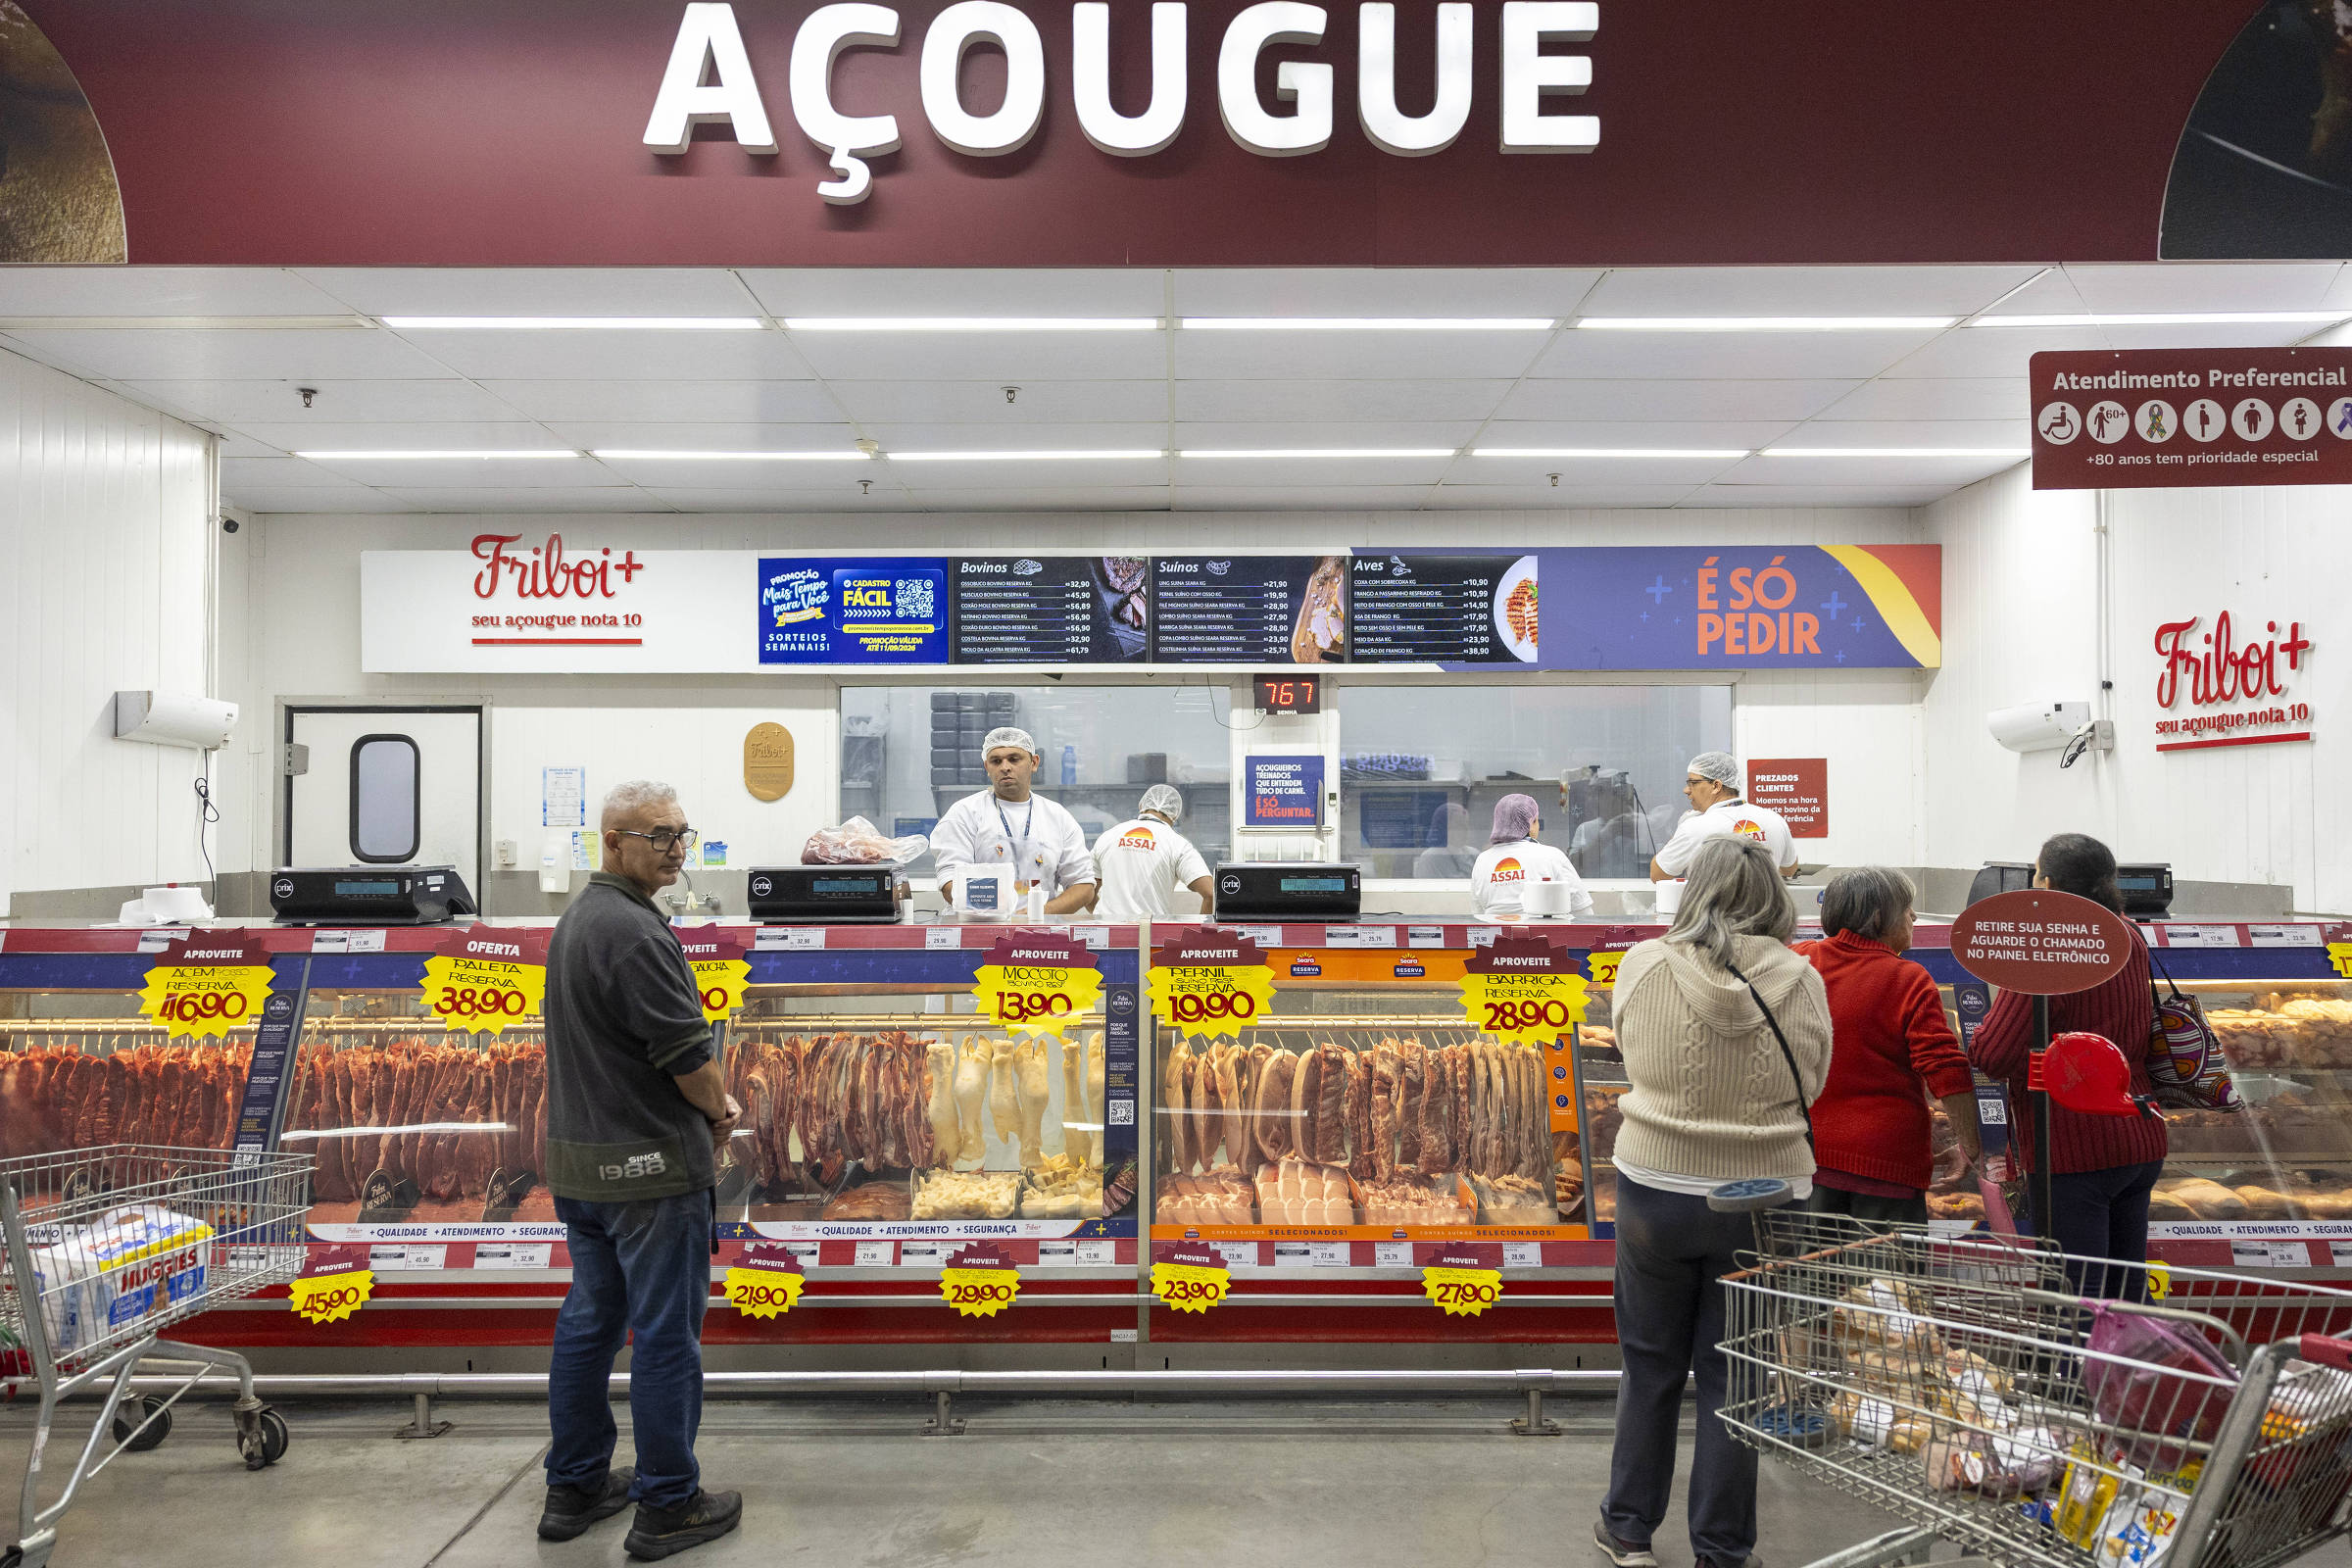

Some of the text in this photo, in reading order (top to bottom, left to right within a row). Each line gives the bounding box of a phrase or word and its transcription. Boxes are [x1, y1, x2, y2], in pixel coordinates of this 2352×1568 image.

[643, 0, 1601, 206] AÇOUGUE
[2053, 368, 2346, 390] Atendimento Preferencial
[2106, 410, 2126, 419] 60+
[2086, 450, 2318, 466] +80 anos tem prioridade especial
[961, 562, 1007, 572] Bovinos
[1159, 562, 1199, 572] Suínos
[1354, 560, 1384, 571] Aves
[770, 569, 819, 586] PROMOÇÃO
[1698, 556, 1796, 610] É SÓ
[762, 580, 828, 606] Mais Tempo
[844, 588, 892, 606] FÁCIL
[774, 602, 800, 617] para
[801, 593, 829, 609] Você
[472, 613, 642, 629] seu açougue nota 10
[859, 636, 899, 645] PROMOÇÃO
[1698, 612, 1822, 655] PEDIR
[2156, 703, 2308, 736] seu açougue nota 10
[1256, 796, 1278, 808] É SÓ
[1256, 808, 1314, 817] PERGUNTAR.
[1118, 838, 1156, 852] ASSAI
[1491, 870, 1525, 883] ASSAI
[276, 884, 292, 894] prix
[754, 882, 771, 891] prix
[1976, 921, 2099, 934] RETIRE SUA SENHA E
[467, 941, 519, 956] OFERTA
[1971, 936, 2105, 949] AGUARDE O CHAMADO
[184, 950, 243, 958] APROVEITE
[1011, 950, 1069, 958] APROVEITE
[1181, 950, 1238, 958] APROVEITE
[1967, 949, 2109, 964] NO PAINEL ELETRÔNICO
[453, 958, 522, 974] PALETA
[1493, 957, 1550, 966] APROVEITE
[172, 968, 216, 977] ACEM
[1167, 967, 1232, 977] PERNIL
[449, 972, 518, 989] RESERVA
[1484, 975, 1566, 985] BARRIGA
[1169, 984, 1237, 993] RESERVA
[1486, 989, 1551, 998] RESERVA
[159, 992, 247, 1025] 46,90
[434, 987, 525, 1020] 38,90
[997, 992, 1072, 1022] 13,90
[1485, 1001, 1569, 1033] 28,90
[628, 1152, 662, 1163] SINCE
[599, 1159, 666, 1181] 1988
[376, 1227, 566, 1237] QUALIDADE ATENDIMENTO SEGURANÇ
[886, 1225, 949, 1235] ATENDIMENTO
[964, 1225, 1016, 1235] SEGURANÇA
[315, 1261, 353, 1273] APROVEITE
[749, 1258, 785, 1268] APROVEITE
[122, 1249, 196, 1293] HUGGIES
[734, 1286, 787, 1308] 21,90
[952, 1285, 1011, 1305] 29,90
[1163, 1281, 1219, 1303] 23,90
[1437, 1283, 1495, 1306] 27,90
[302, 1286, 360, 1316] 45,90
